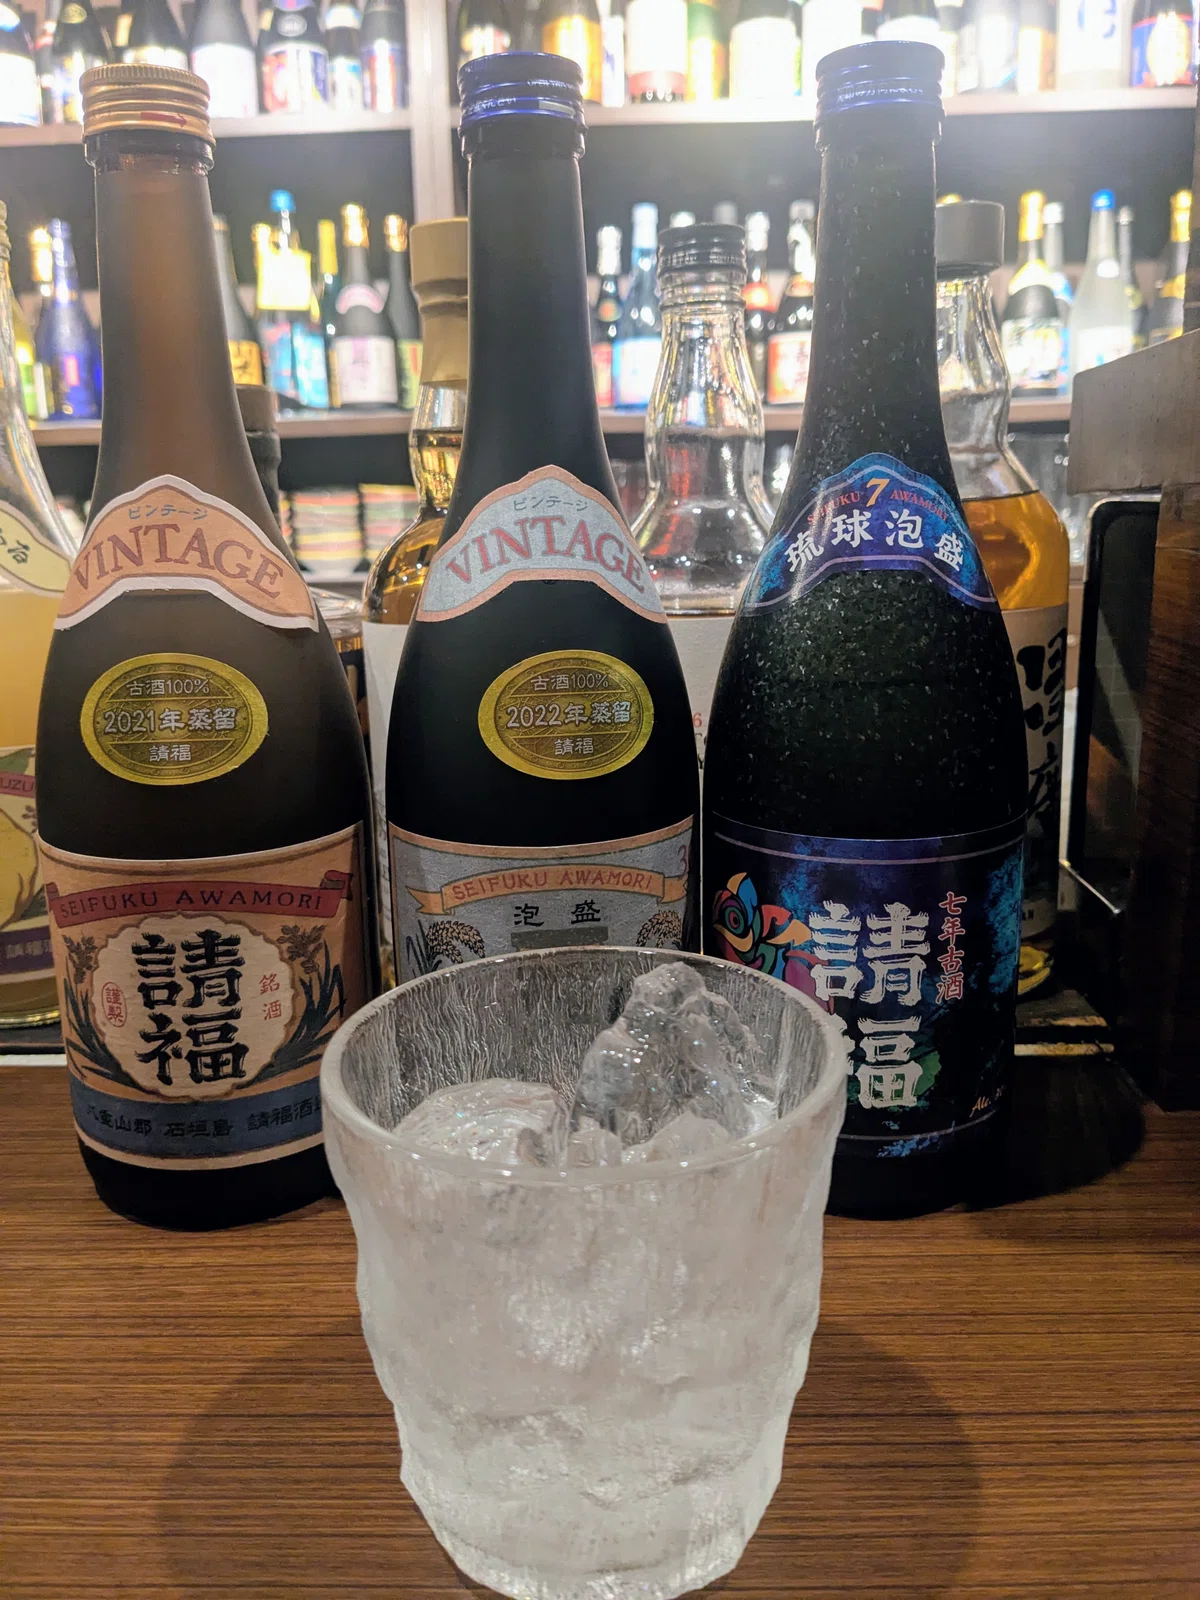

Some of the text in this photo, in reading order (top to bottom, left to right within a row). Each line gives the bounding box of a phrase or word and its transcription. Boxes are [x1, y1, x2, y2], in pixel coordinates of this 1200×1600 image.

[513, 495, 588, 511] ビンテージ
[865, 477, 890, 507] 7
[128, 504, 208, 520] ビンテージ
[446, 515, 645, 593] VINTAGE
[786, 508, 964, 572] 琉球泡盛
[74, 523, 284, 599] VINTAGE
[126, 679, 210, 696] 古酒100%
[530, 673, 609, 691] 古酒100%
[103, 708, 238, 733] 2021年蒸留
[505, 701, 632, 728] 2022年蒸留
[149, 745, 192, 762] 請福
[554, 736, 595, 755] 請福
[451, 869, 652, 900] SEIFUKU AWAMORI
[59, 890, 322, 918] SEIFUKU AWAMORI
[936, 891, 968, 1004] 七年古酒
[131, 929, 249, 1086] 請福
[258, 973, 283, 1021] 銘酒
